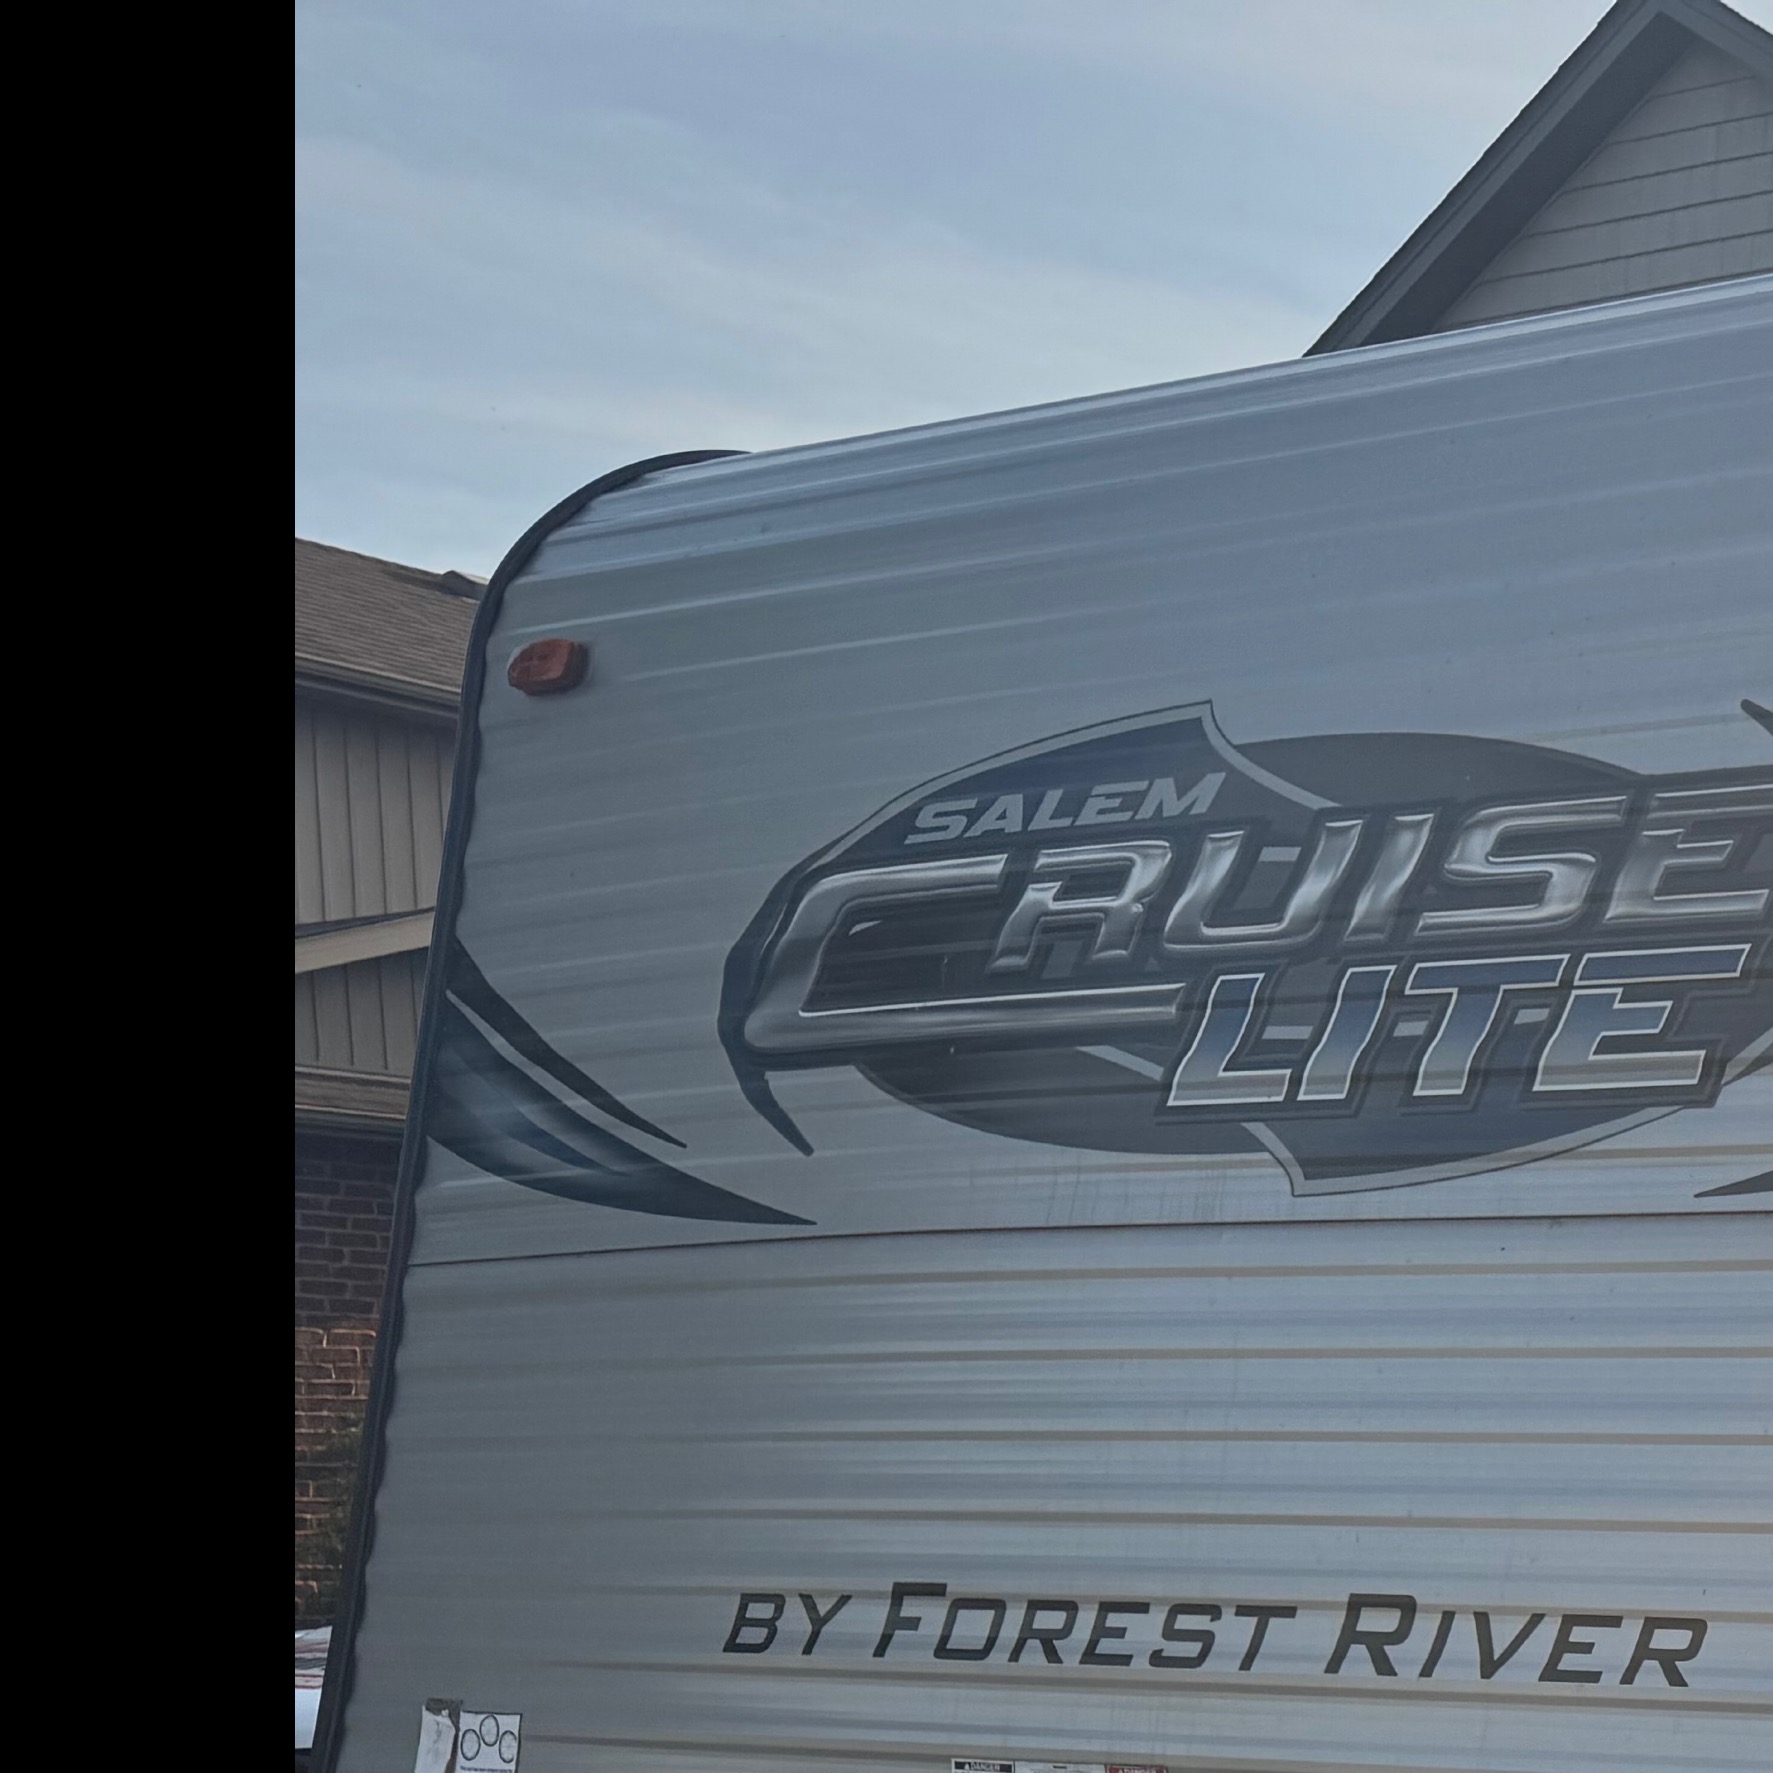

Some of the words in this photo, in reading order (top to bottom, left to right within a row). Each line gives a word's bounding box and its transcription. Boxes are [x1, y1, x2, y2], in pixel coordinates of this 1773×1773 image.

[902, 771, 1226, 843] SALEM
[1166, 942, 1753, 1108] LITE
[872, 1581, 1298, 1672] FOREST
[1324, 1591, 1709, 1688] RIVER
